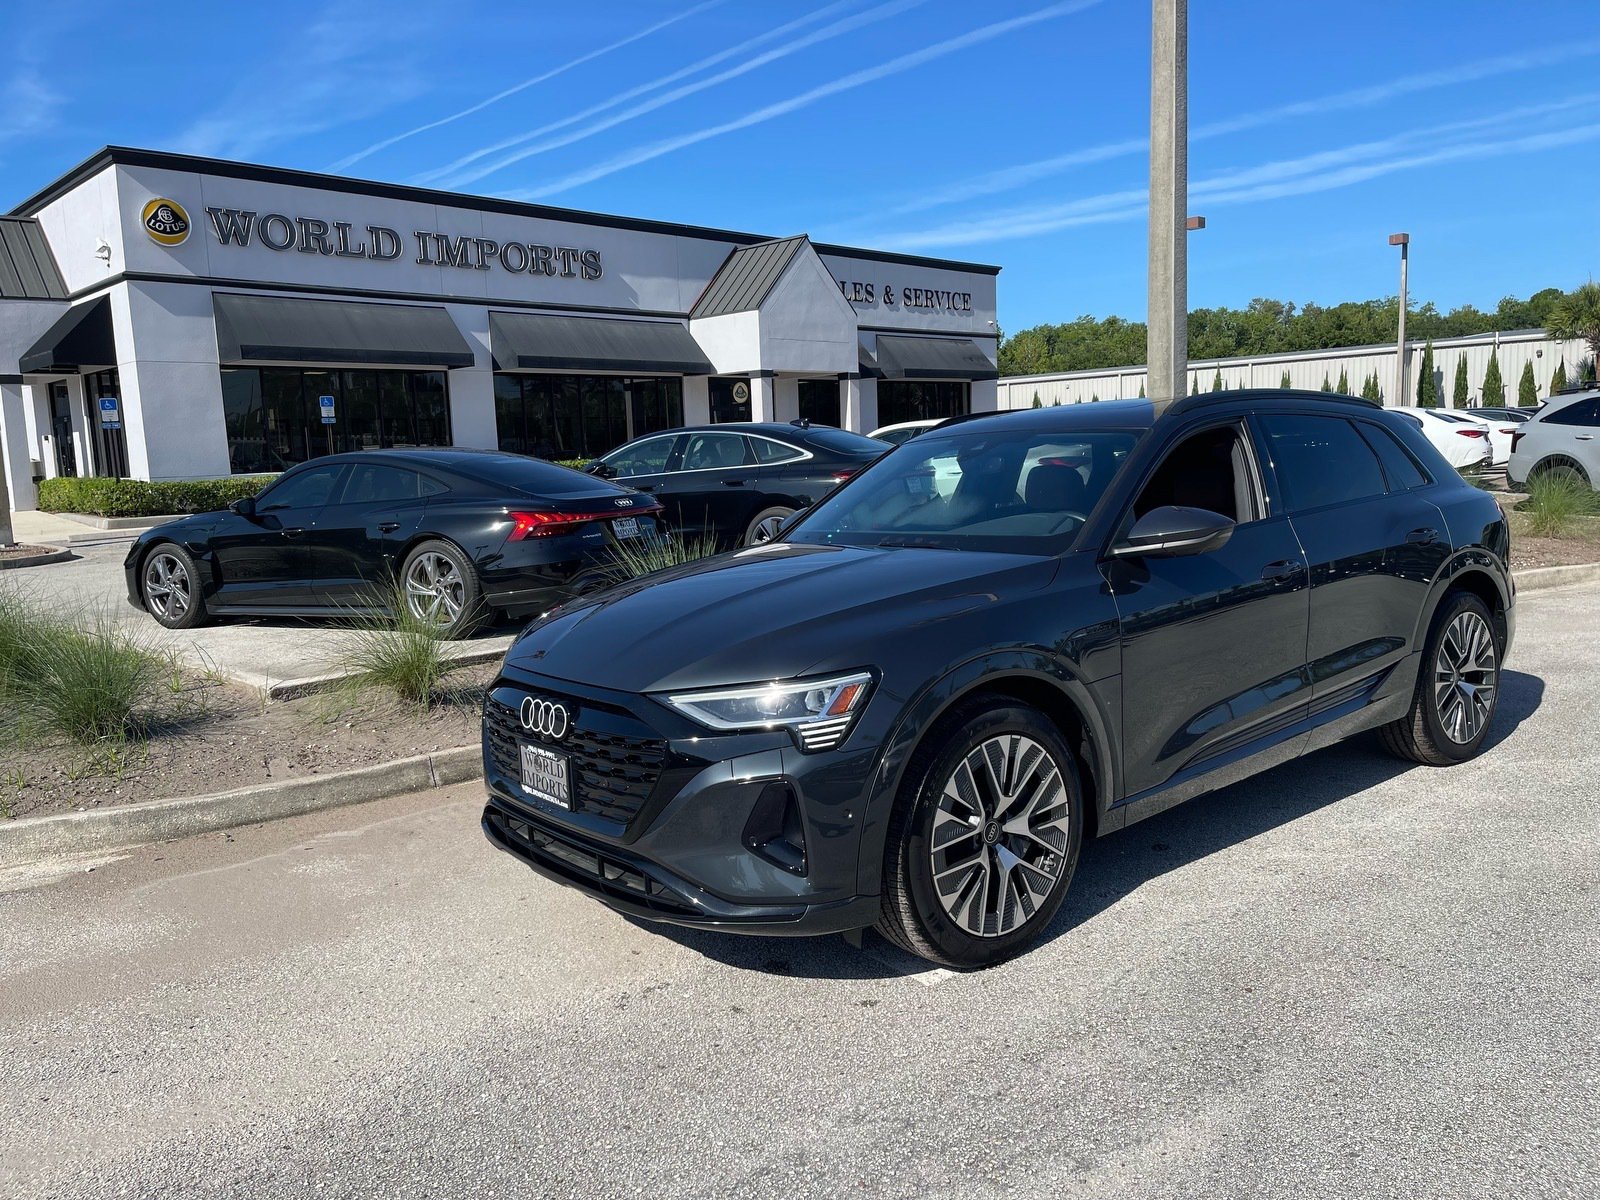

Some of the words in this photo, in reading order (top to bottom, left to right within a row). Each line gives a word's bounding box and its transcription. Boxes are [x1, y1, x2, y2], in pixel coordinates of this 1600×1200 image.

[149, 219, 186, 232] LOTUS
[205, 206, 404, 261] WORLD
[413, 231, 604, 281] IMPORTS
[883, 285, 895, 305] &
[903, 287, 971, 312] SERVICE
[524, 751, 564, 779] WORLD
[523, 769, 568, 800] IMPORTS
